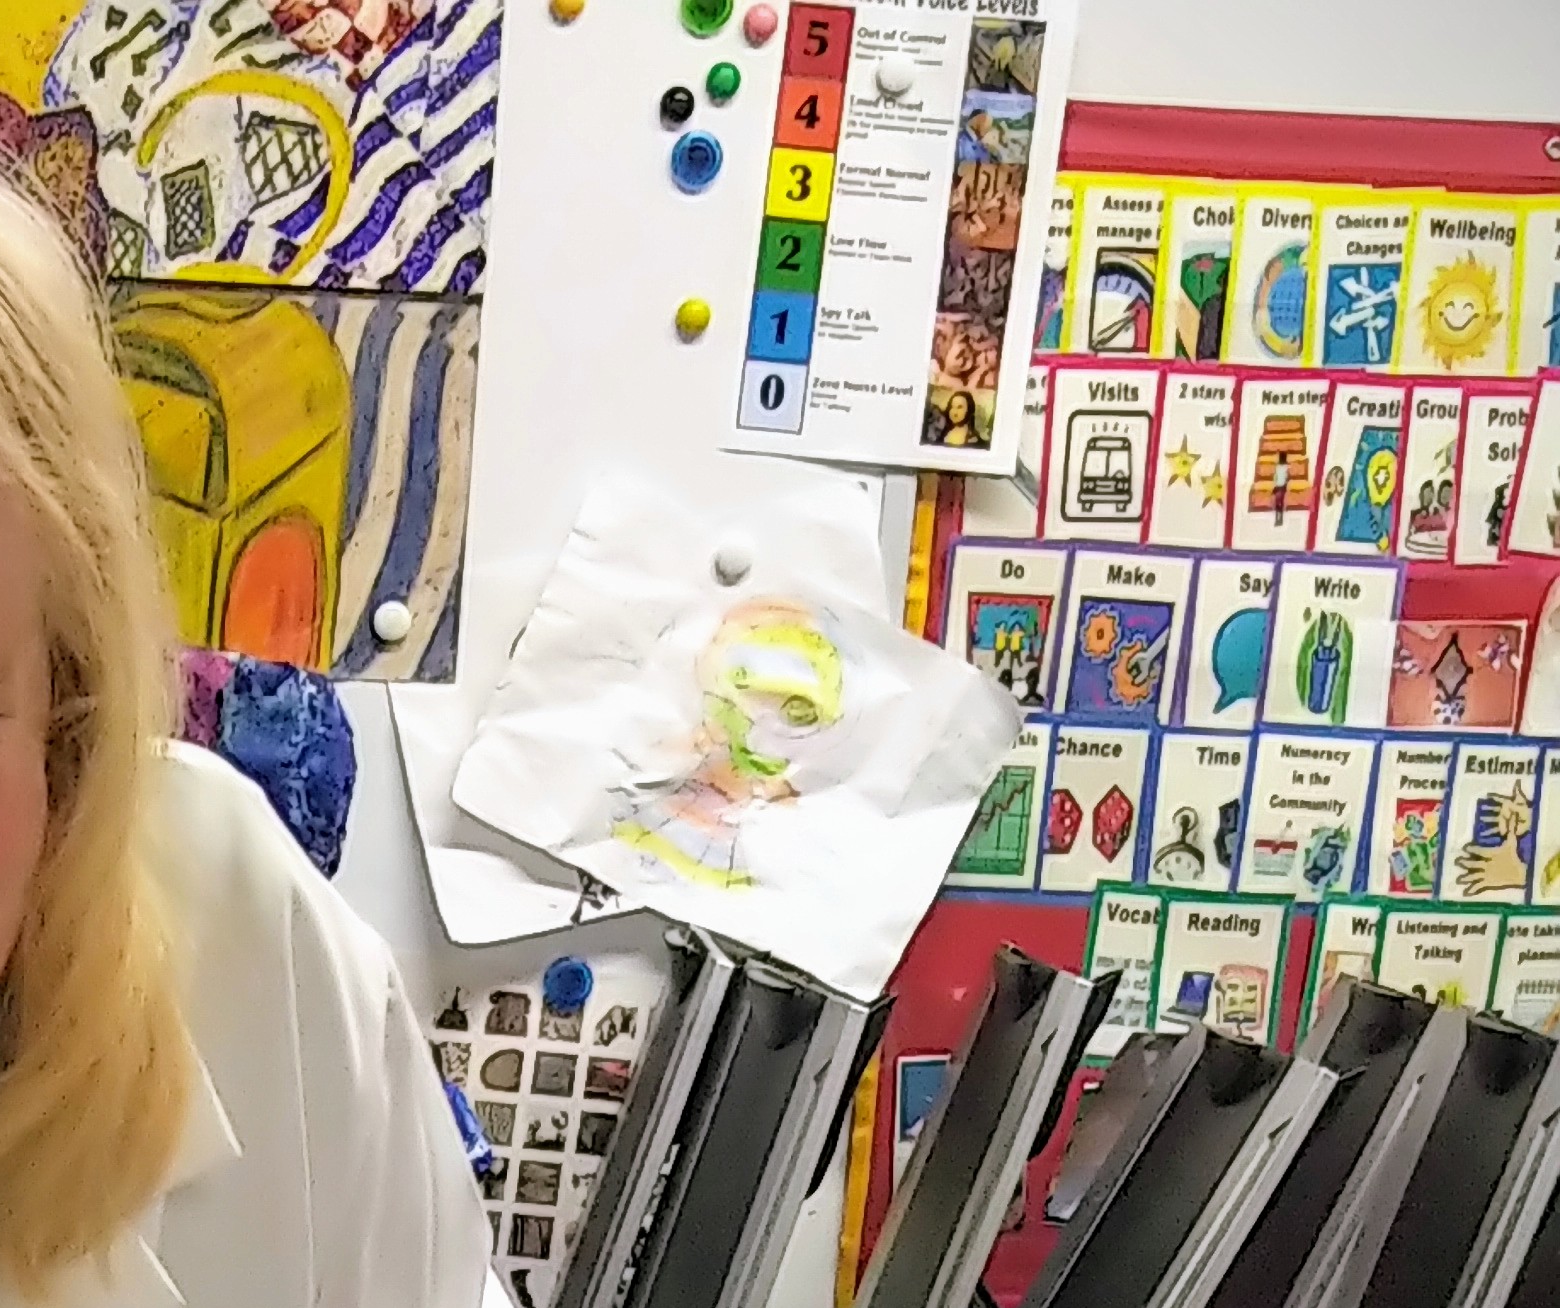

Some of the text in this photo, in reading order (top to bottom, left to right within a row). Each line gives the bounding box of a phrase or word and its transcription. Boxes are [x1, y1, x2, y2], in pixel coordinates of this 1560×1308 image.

[803, 22, 830, 58] 5
[795, 94, 820, 129] 4
[786, 164, 813, 202] 3
[1102, 195, 1152, 211] Assess
[1336, 215, 1388, 230] Choices
[1430, 218, 1516, 247] Wellbeing
[1097, 225, 1151, 242] manage
[775, 234, 801, 272] 2
[1347, 241, 1402, 257] Changes
[770, 308, 790, 345] 1
[760, 374, 785, 410] 0
[1088, 381, 1139, 402] Visits
[1179, 382, 1226, 399] 2 stars
[1262, 390, 1293, 405] Next
[1204, 412, 1231, 428] wis
[1000, 559, 1025, 580] Do
[1107, 564, 1156, 587] Make
[1239, 572, 1273, 598] Say
[1314, 577, 1361, 600] Write
[1055, 736, 1123, 759] Chance
[1197, 746, 1241, 767] Time
[1280, 744, 1350, 766] Numeracy
[1397, 750, 1451, 766] Number
[1292, 770, 1330, 786] in the
[1269, 794, 1346, 816] Community
[1186, 913, 1261, 938] Reading
[1396, 920, 1488, 938] Listening and
[1414, 944, 1462, 963] Talking
